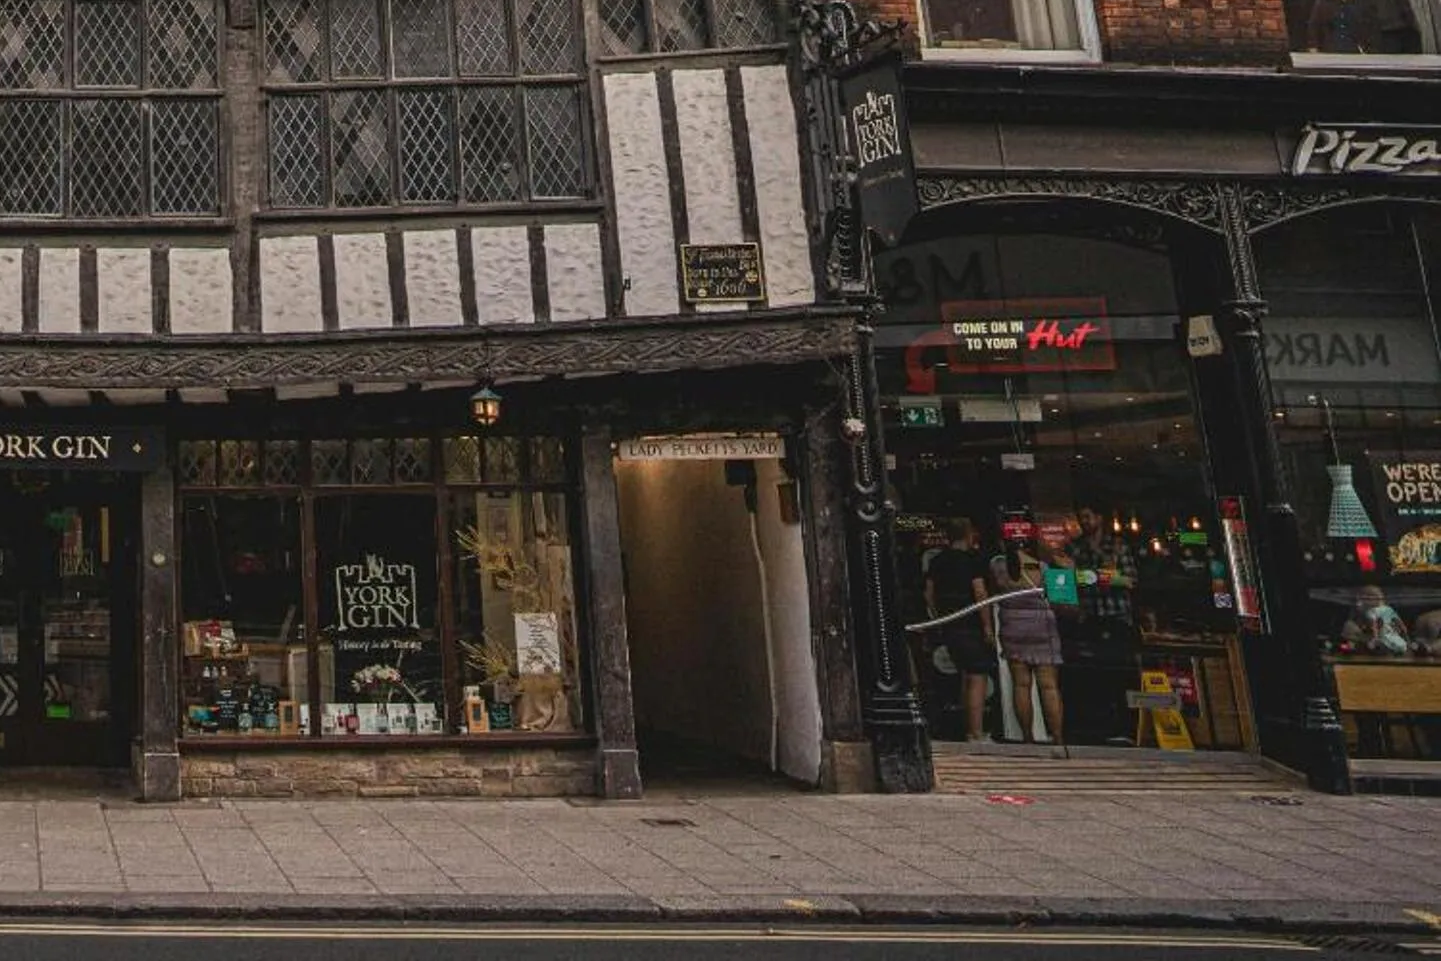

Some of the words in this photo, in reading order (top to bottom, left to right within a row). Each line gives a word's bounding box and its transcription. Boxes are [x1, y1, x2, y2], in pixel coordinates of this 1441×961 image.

[859, 115, 893, 142] YORK
[863, 136, 894, 162] GIN
[1292, 124, 1441, 176] Pizza
[953, 321, 989, 334] COME
[990, 320, 1008, 334] ON
[1026, 319, 1099, 351] Hut
[965, 338, 983, 351] TO
[984, 337, 1018, 350] YOUR
[51, 435, 113, 459] GIN
[629, 442, 663, 456] LADY
[742, 439, 778, 455] YARD
[344, 586, 412, 606] YORK
[347, 604, 410, 628] GIN
